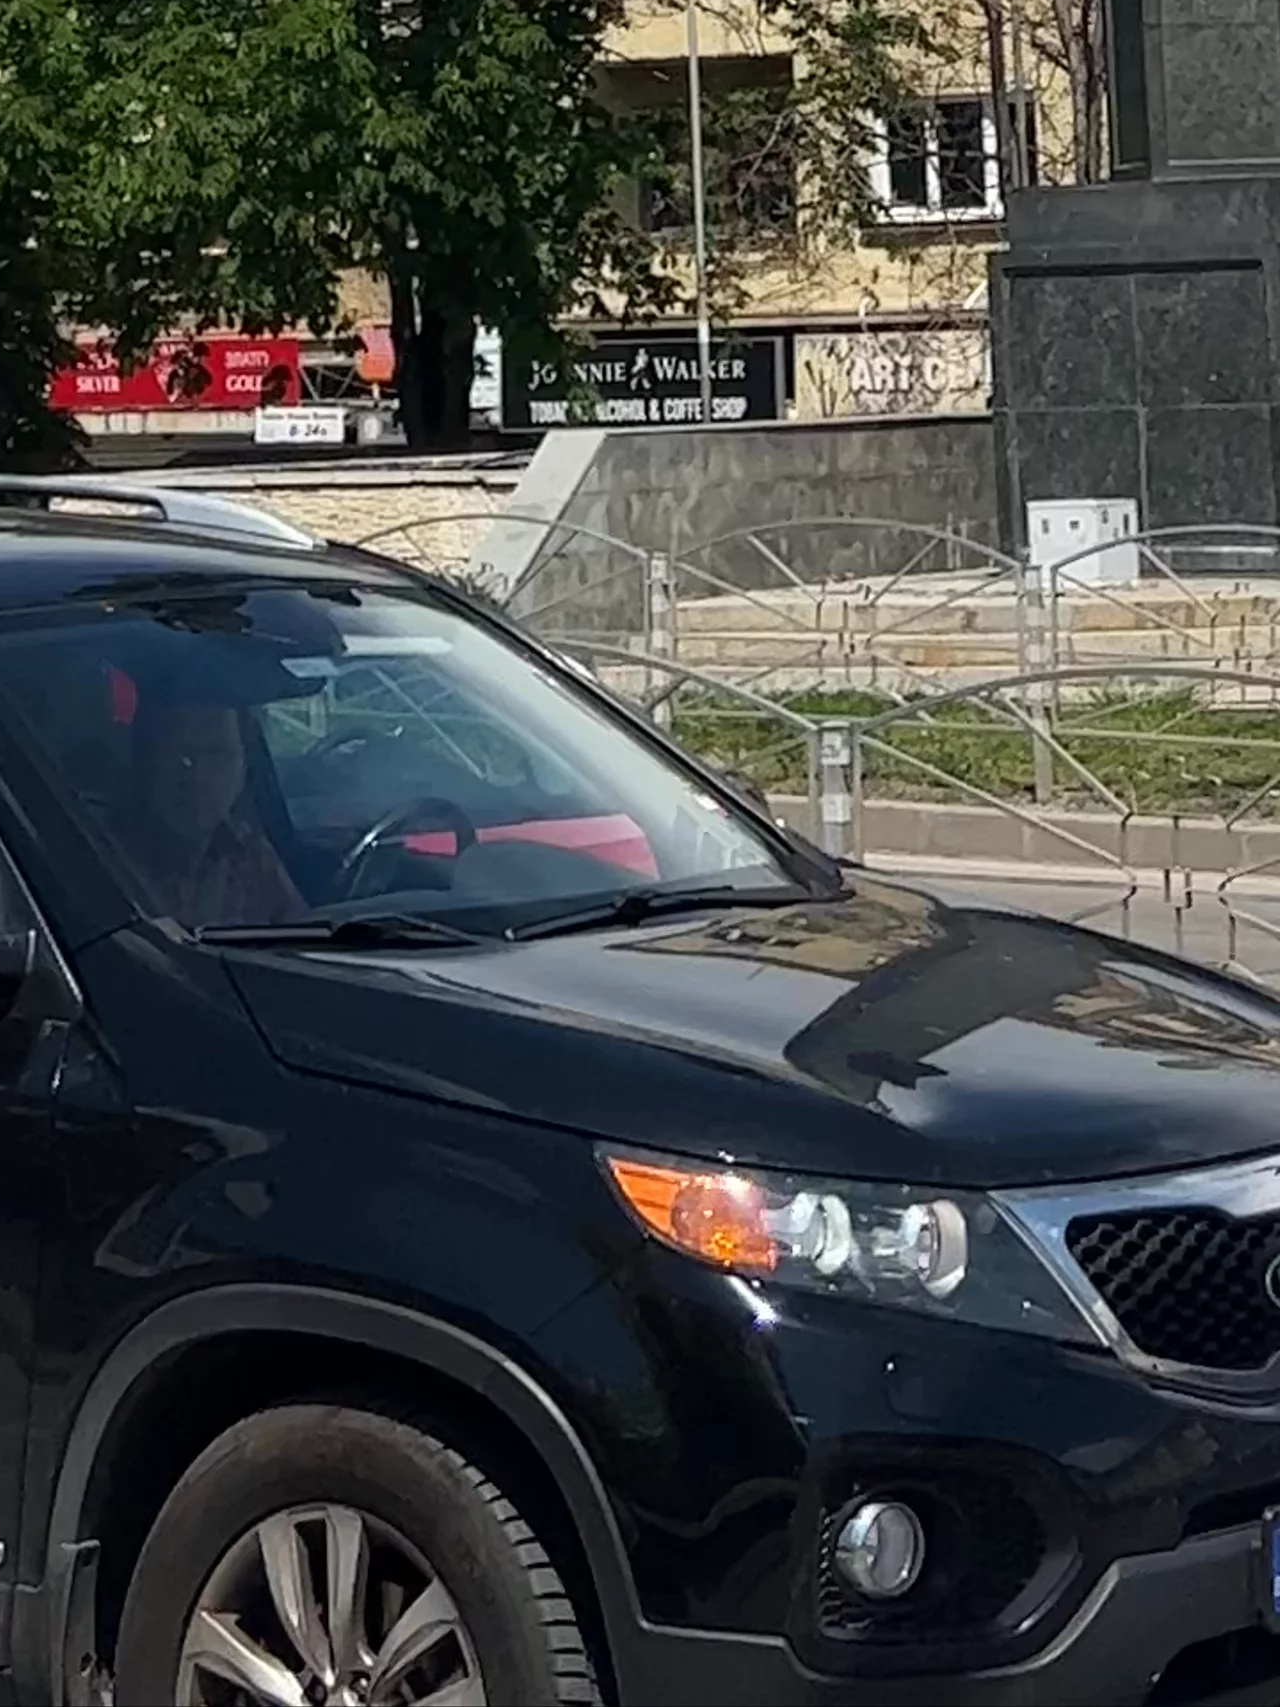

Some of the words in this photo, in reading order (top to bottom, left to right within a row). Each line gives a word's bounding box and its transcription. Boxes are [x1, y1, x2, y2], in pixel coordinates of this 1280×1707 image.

[76, 375, 121, 393] SILVER
[528, 360, 626, 391] JONNIE
[851, 354, 913, 392] ART
[649, 398, 660, 421] &
[664, 398, 707, 421] COFFE
[712, 396, 748, 419] SHOP
